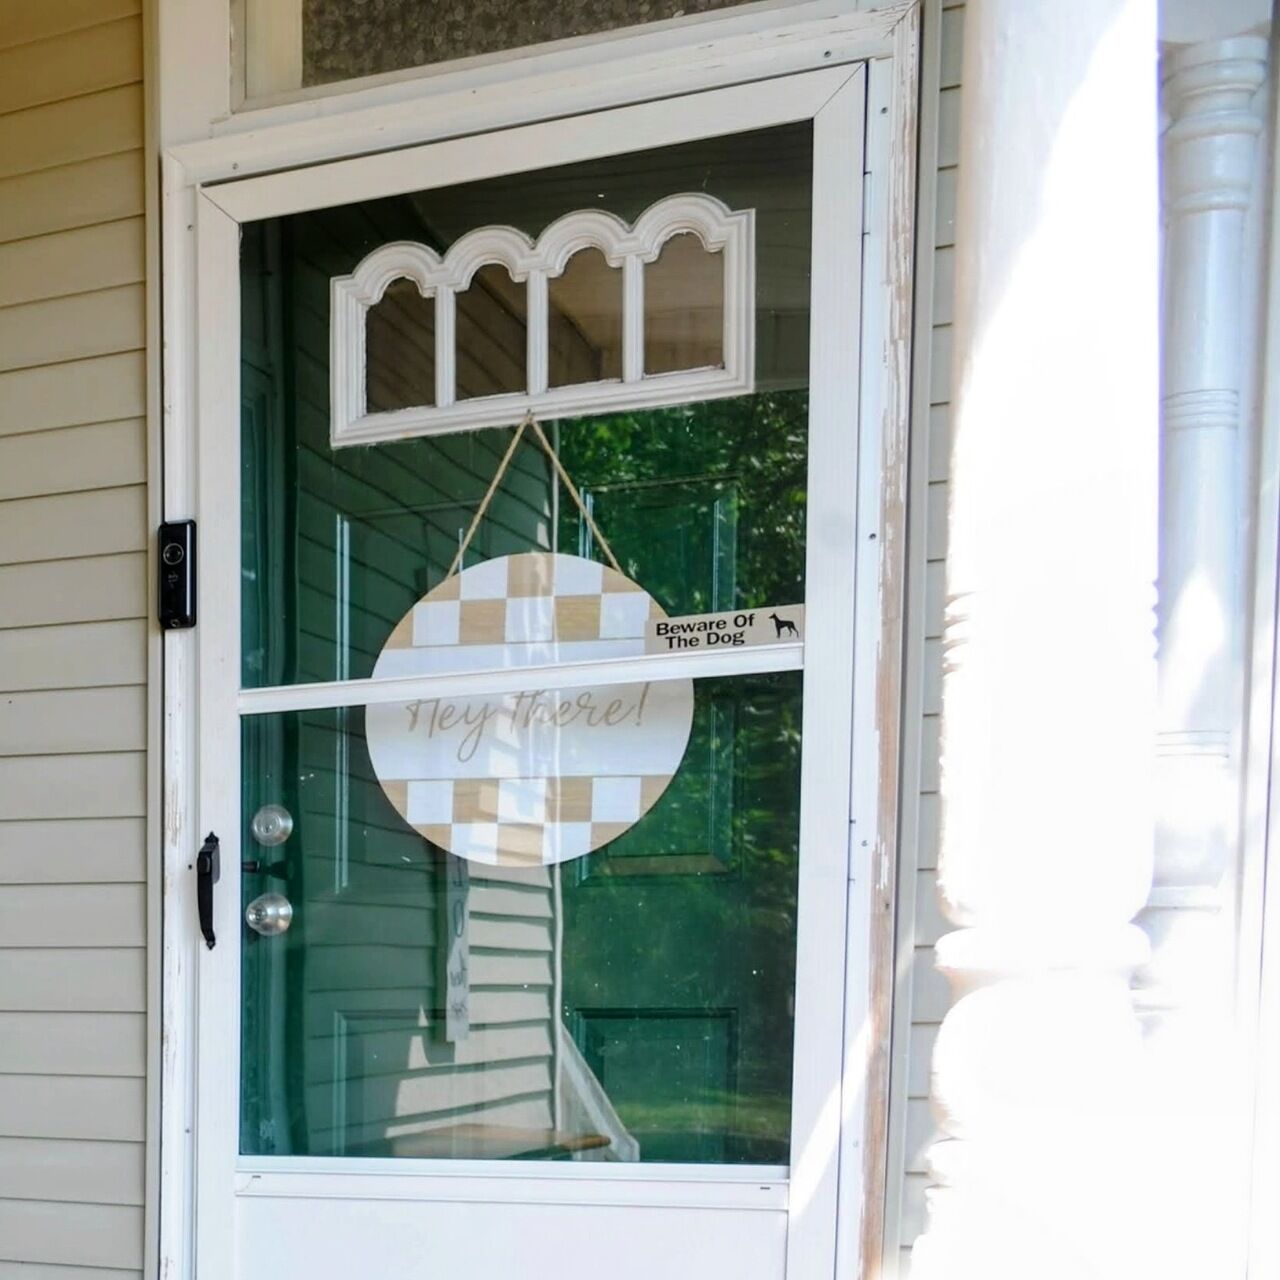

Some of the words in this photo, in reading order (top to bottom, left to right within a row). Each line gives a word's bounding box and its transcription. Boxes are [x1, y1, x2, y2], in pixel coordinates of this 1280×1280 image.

[656, 619, 727, 636] Beware
[733, 614, 755, 628] Of
[665, 635, 700, 649] The
[706, 630, 745, 646] Dog
